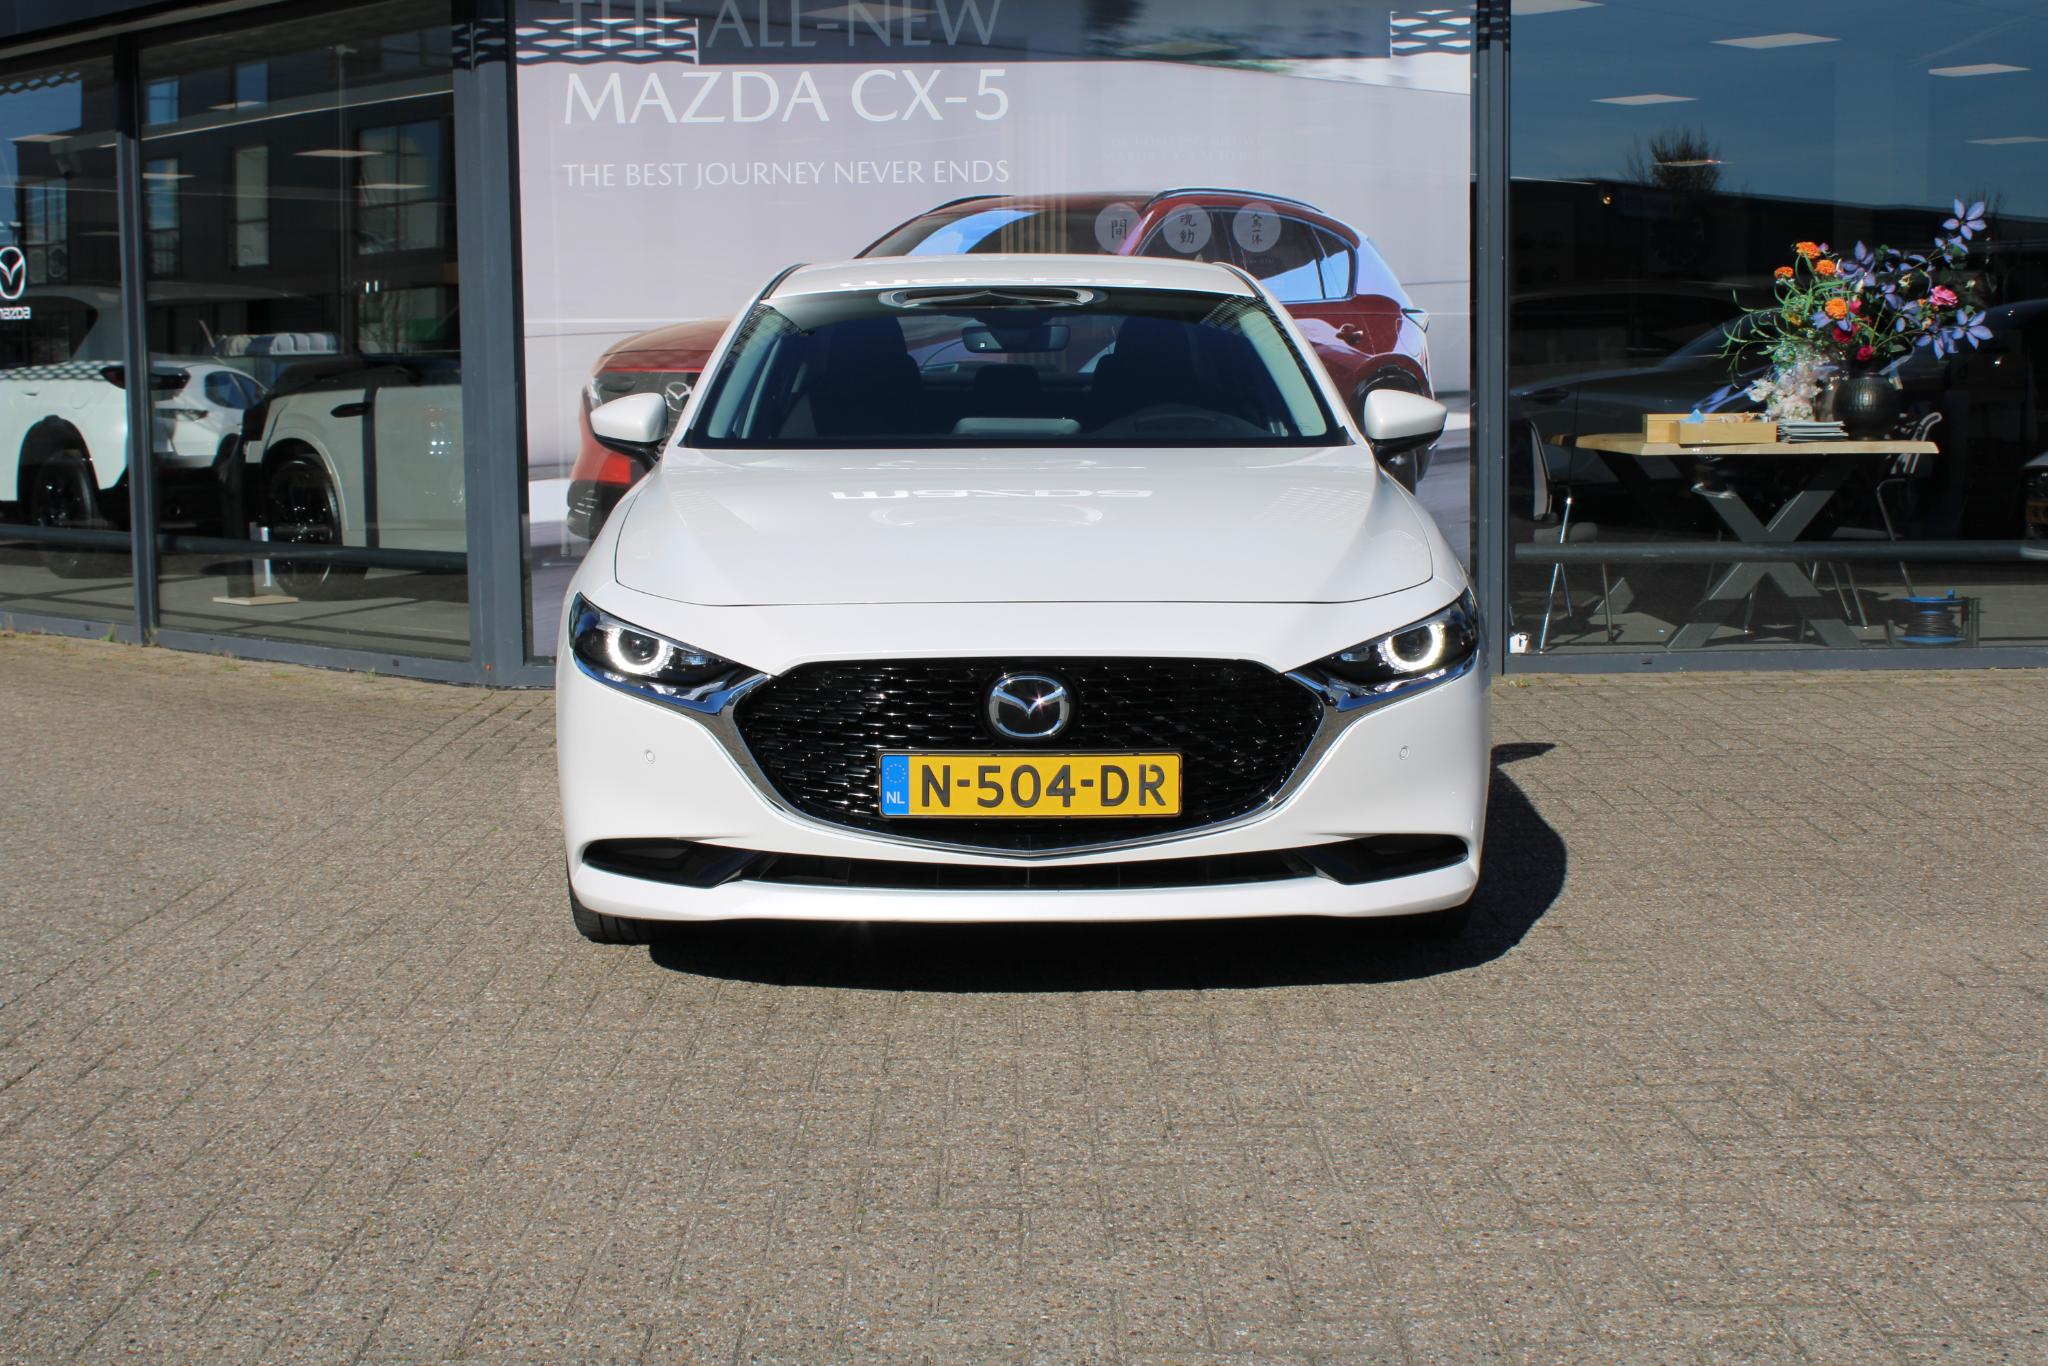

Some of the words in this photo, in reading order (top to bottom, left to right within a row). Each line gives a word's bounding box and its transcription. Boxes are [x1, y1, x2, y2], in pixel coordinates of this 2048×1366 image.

[559, 0, 682, 48] THE
[705, 0, 999, 48] ALL-NEW
[563, 70, 830, 125] MAZDA
[851, 68, 1009, 121] CX-5
[562, 162, 615, 187] THE
[626, 162, 688, 186] BEST
[694, 160, 825, 190] JOURNEY
[834, 160, 926, 184] NEVER
[934, 159, 1009, 184] ENDS
[0, 306, 31, 320] azda
[886, 791, 905, 805] NL
[921, 764, 1167, 809] N-504-DR
